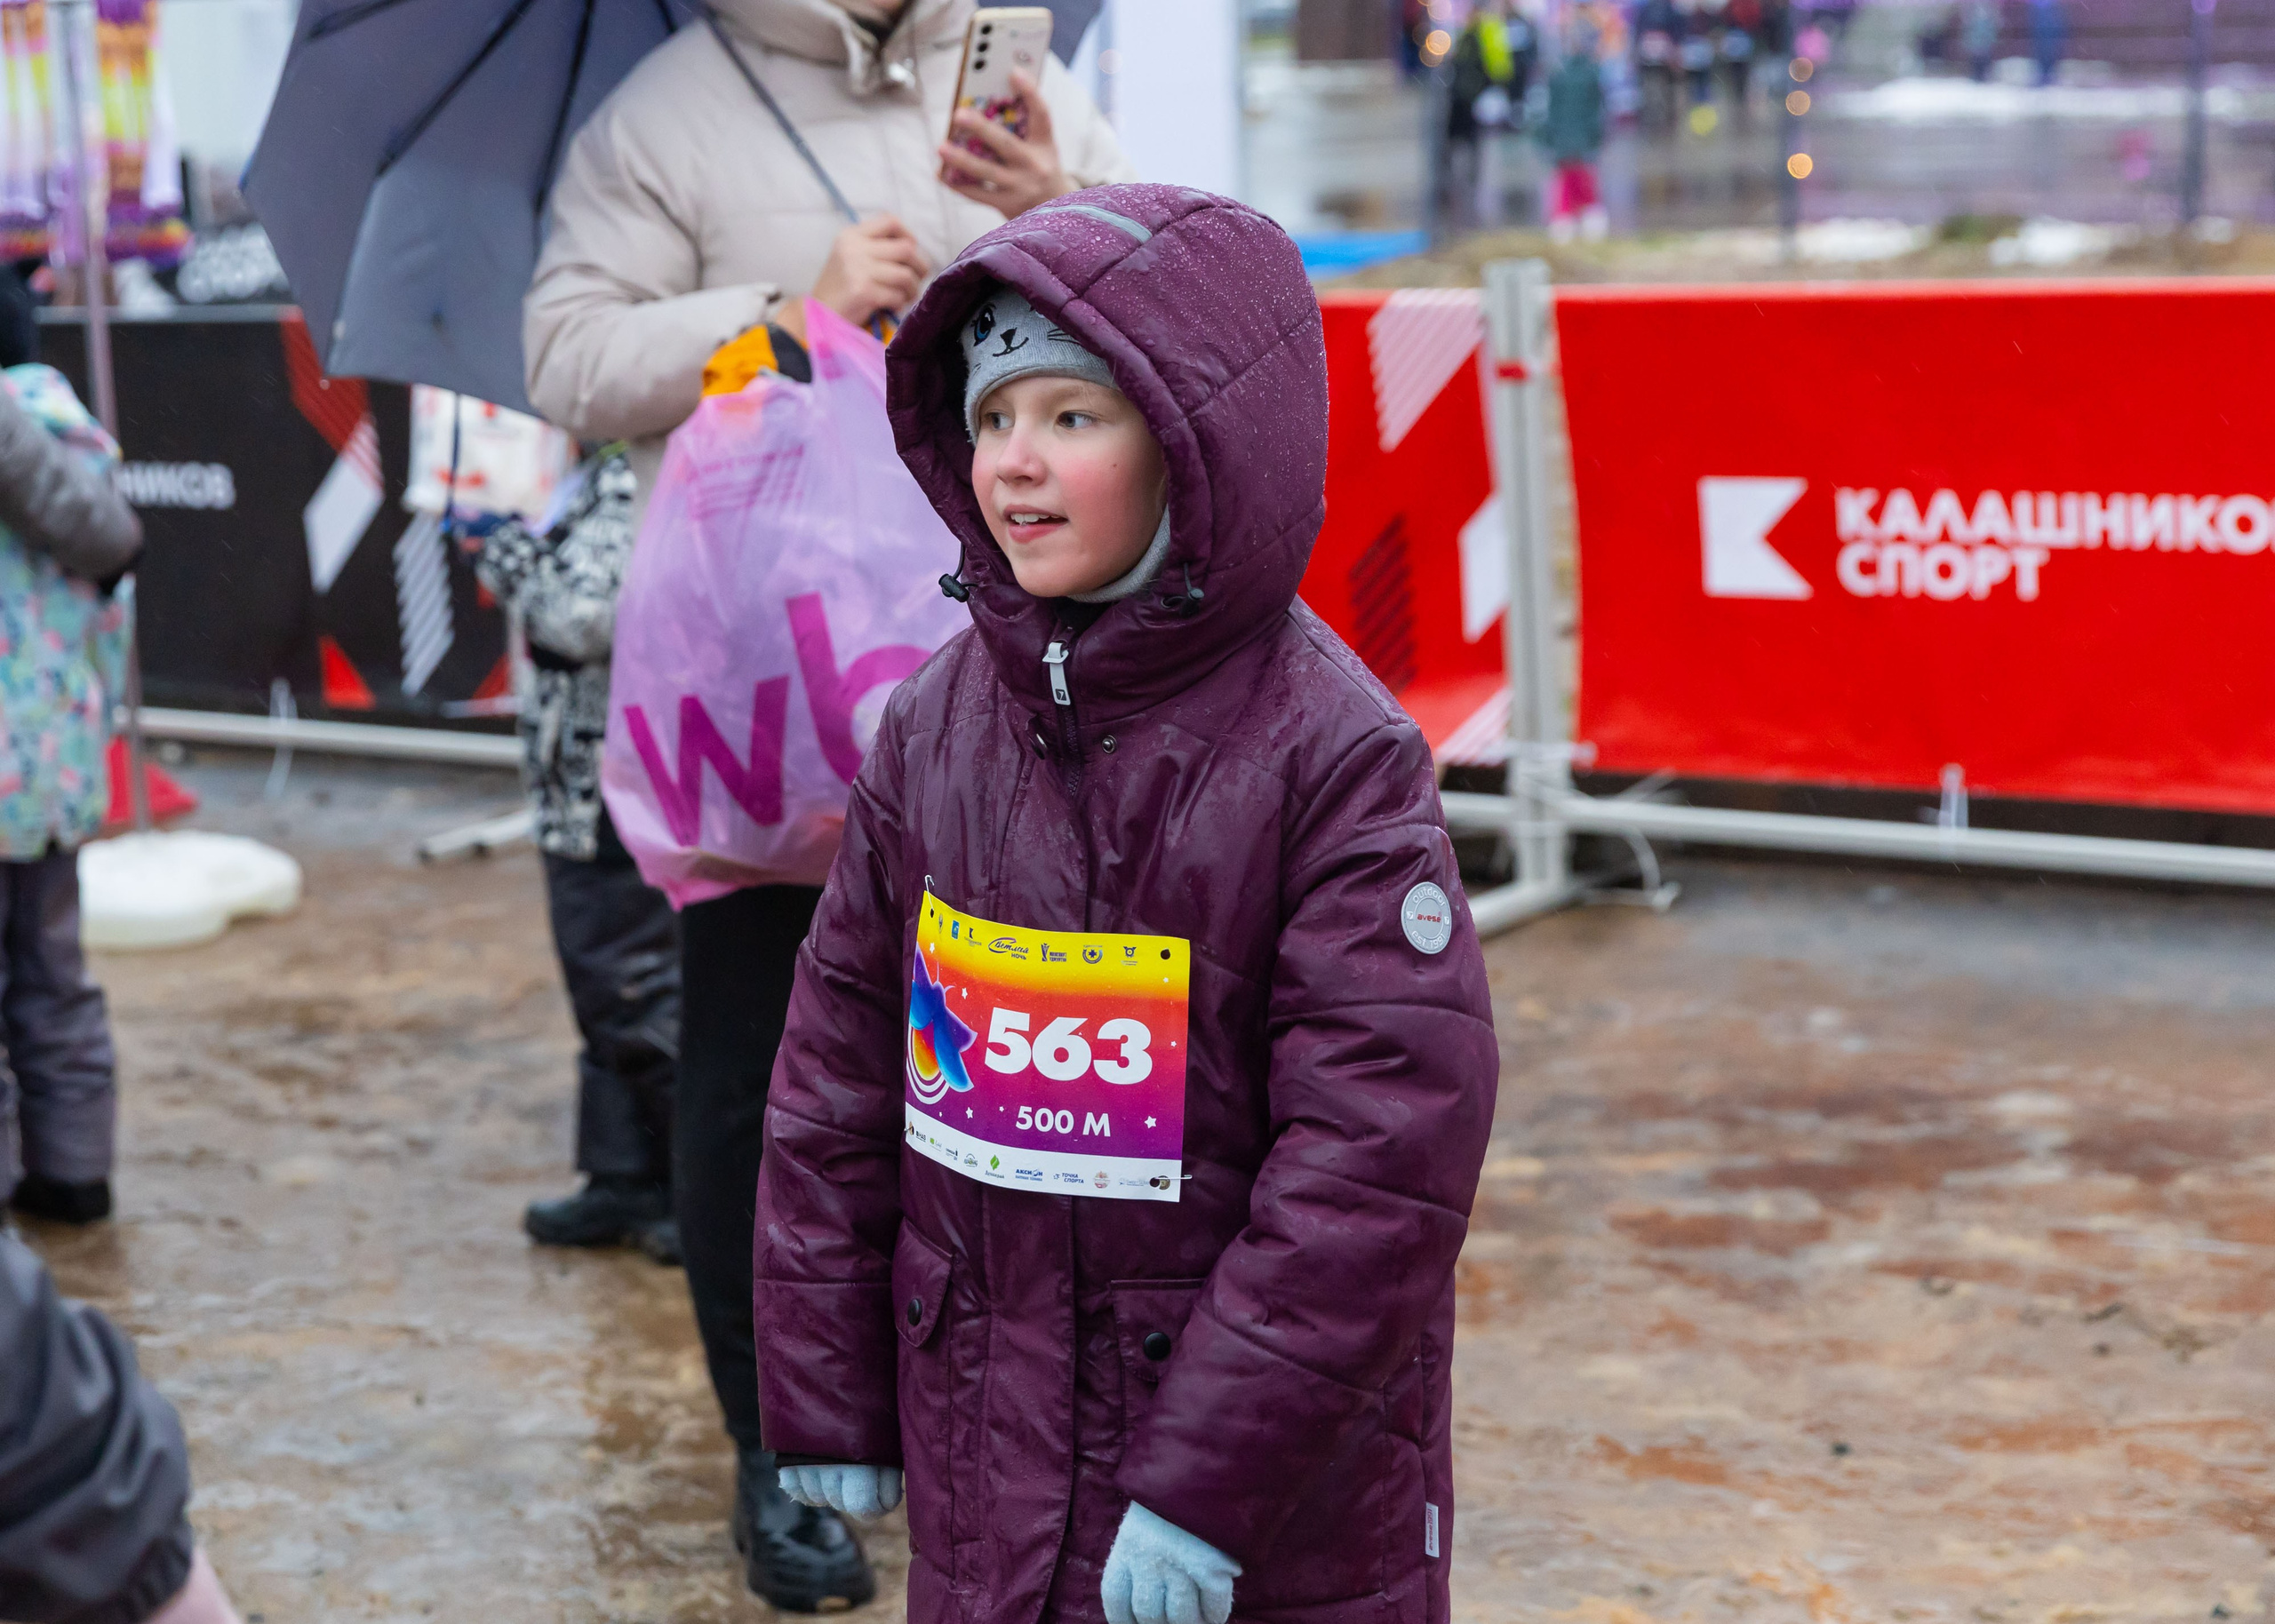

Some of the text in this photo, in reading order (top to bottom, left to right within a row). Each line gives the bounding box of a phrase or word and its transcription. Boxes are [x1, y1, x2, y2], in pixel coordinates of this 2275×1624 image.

[1834, 486, 2275, 556] КАЛАШНИКО
[1836, 540, 2050, 601] СПОРТ
[623, 591, 933, 846] wb
[1413, 887, 1445, 906] outdoor
[1417, 913, 1441, 922] avese
[1430, 933, 1446, 949] 1991
[985, 1007, 1153, 1085] 563
[1016, 1106, 1074, 1134] 500
